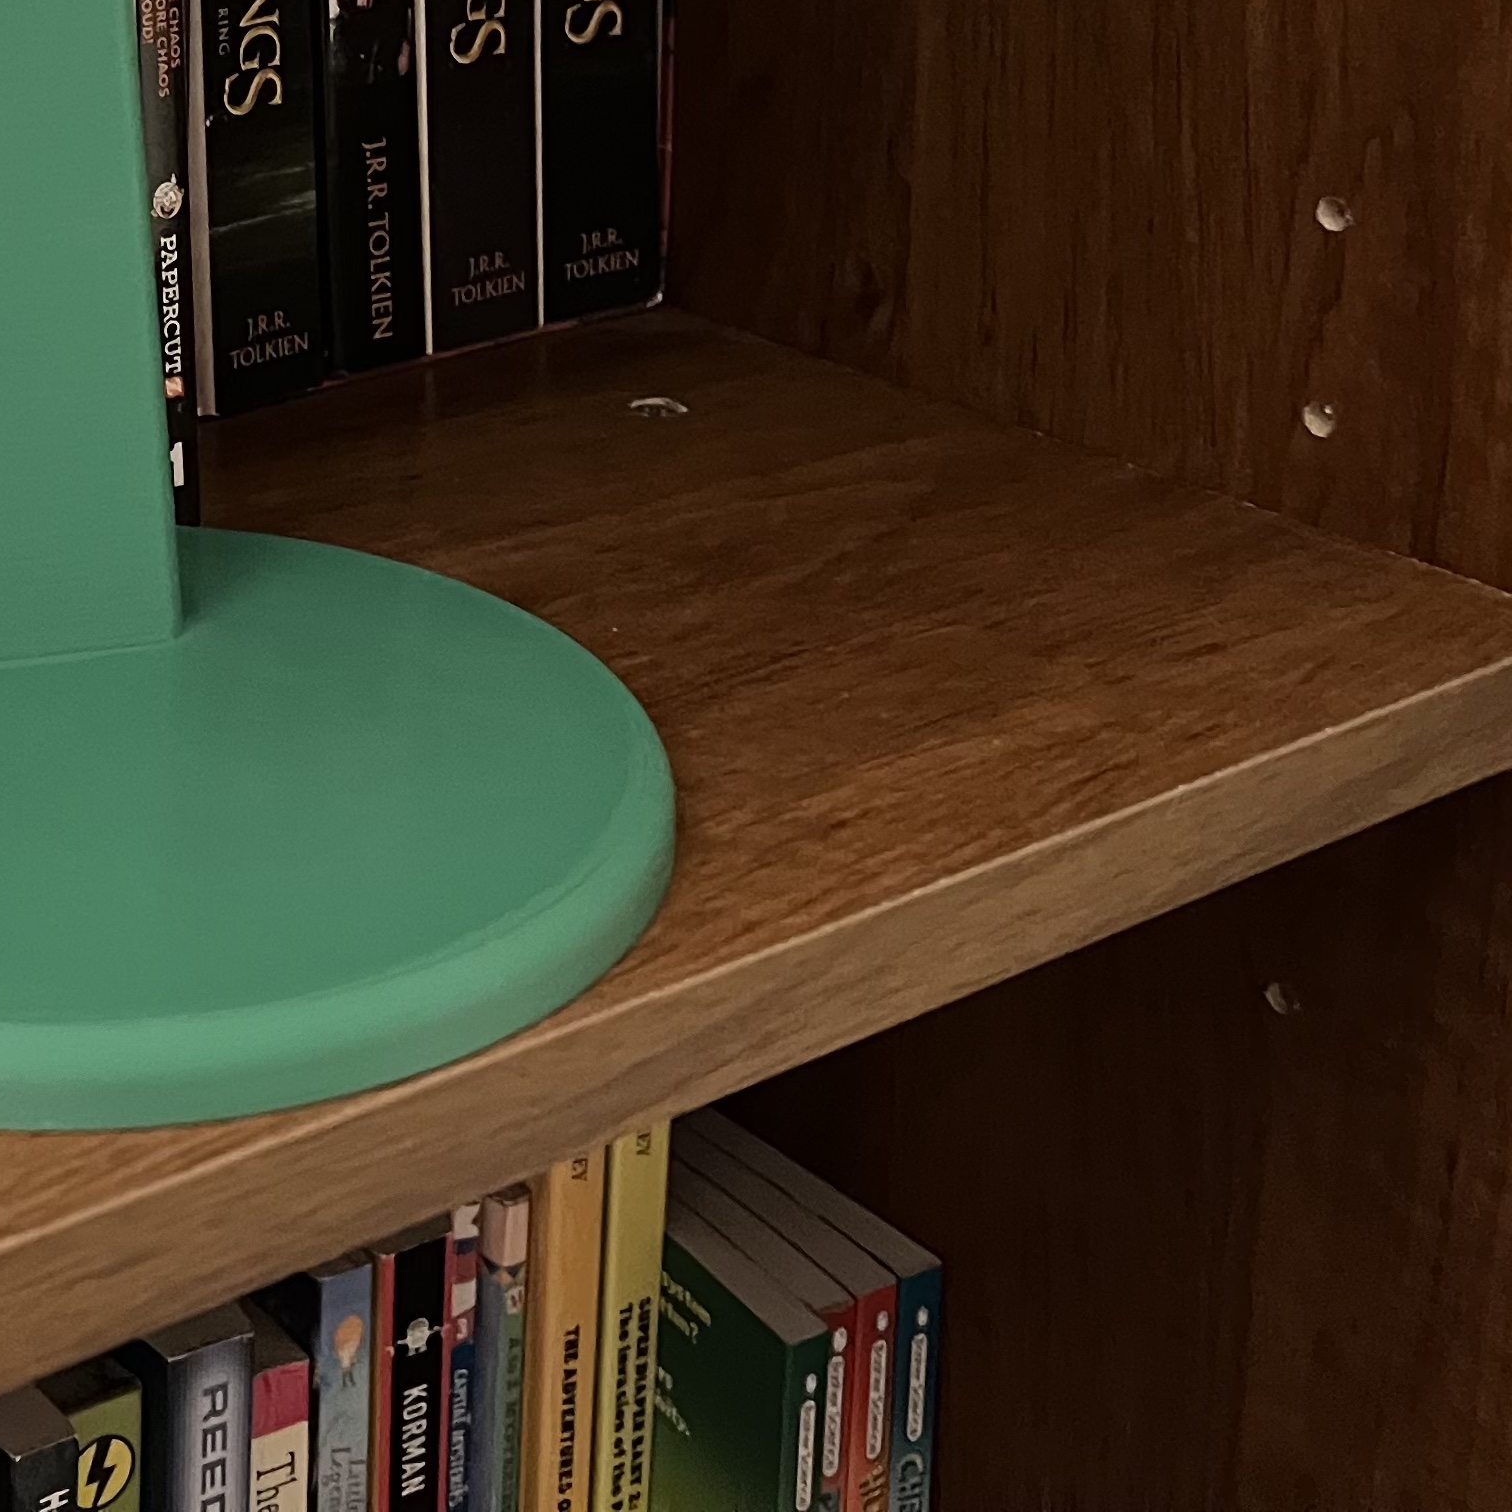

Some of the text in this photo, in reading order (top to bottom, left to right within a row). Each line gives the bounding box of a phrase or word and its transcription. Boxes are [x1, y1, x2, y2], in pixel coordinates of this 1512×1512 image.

[169, 7, 181, 68] CHAOS
[218, 7, 231, 56] RING
[156, 37, 171, 98] CHAOS
[361, 136, 395, 341] J.R.R. TOLKIEN
[468, 250, 510, 277] J.R.R.
[564, 248, 640, 282] TOLKIEN
[580, 226, 624, 253] J.R.R.
[451, 271, 526, 306] TOLKIEN
[229, 332, 310, 369] TOLKIEN
[246, 309, 292, 339] J.R.R.
[635, 1296, 652, 1357] SUPER
[558, 1324, 580, 1494] THE ADVENTURES
[611, 1303, 634, 1497] The the
[401, 1383, 429, 1498] KORMAN
